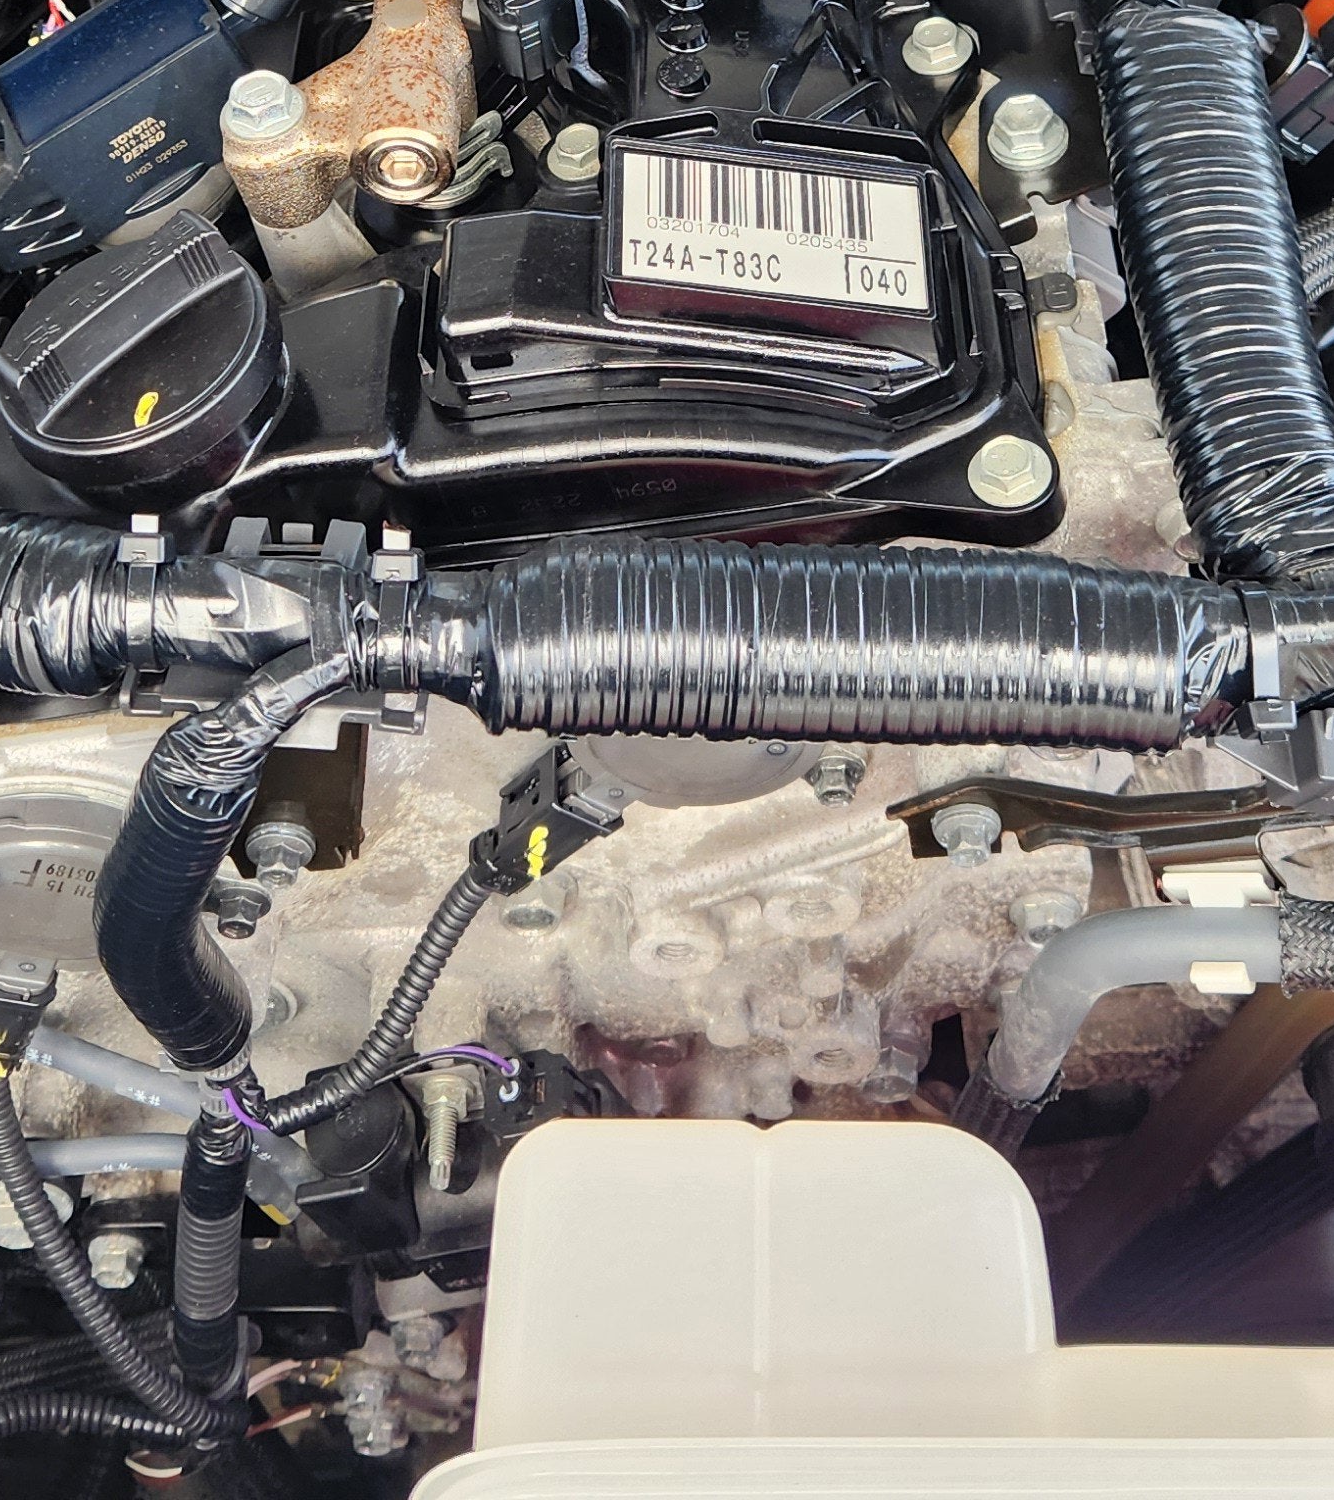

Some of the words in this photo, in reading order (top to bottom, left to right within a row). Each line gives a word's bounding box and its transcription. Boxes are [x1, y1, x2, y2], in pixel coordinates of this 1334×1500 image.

[109, 116, 157, 148] TOYOTA
[122, 130, 166, 164] DENSO
[646, 217, 741, 239] 03201704
[786, 233, 868, 253] 0205435
[628, 238, 782, 282] T24A-T83C
[859, 265, 908, 296] 040
